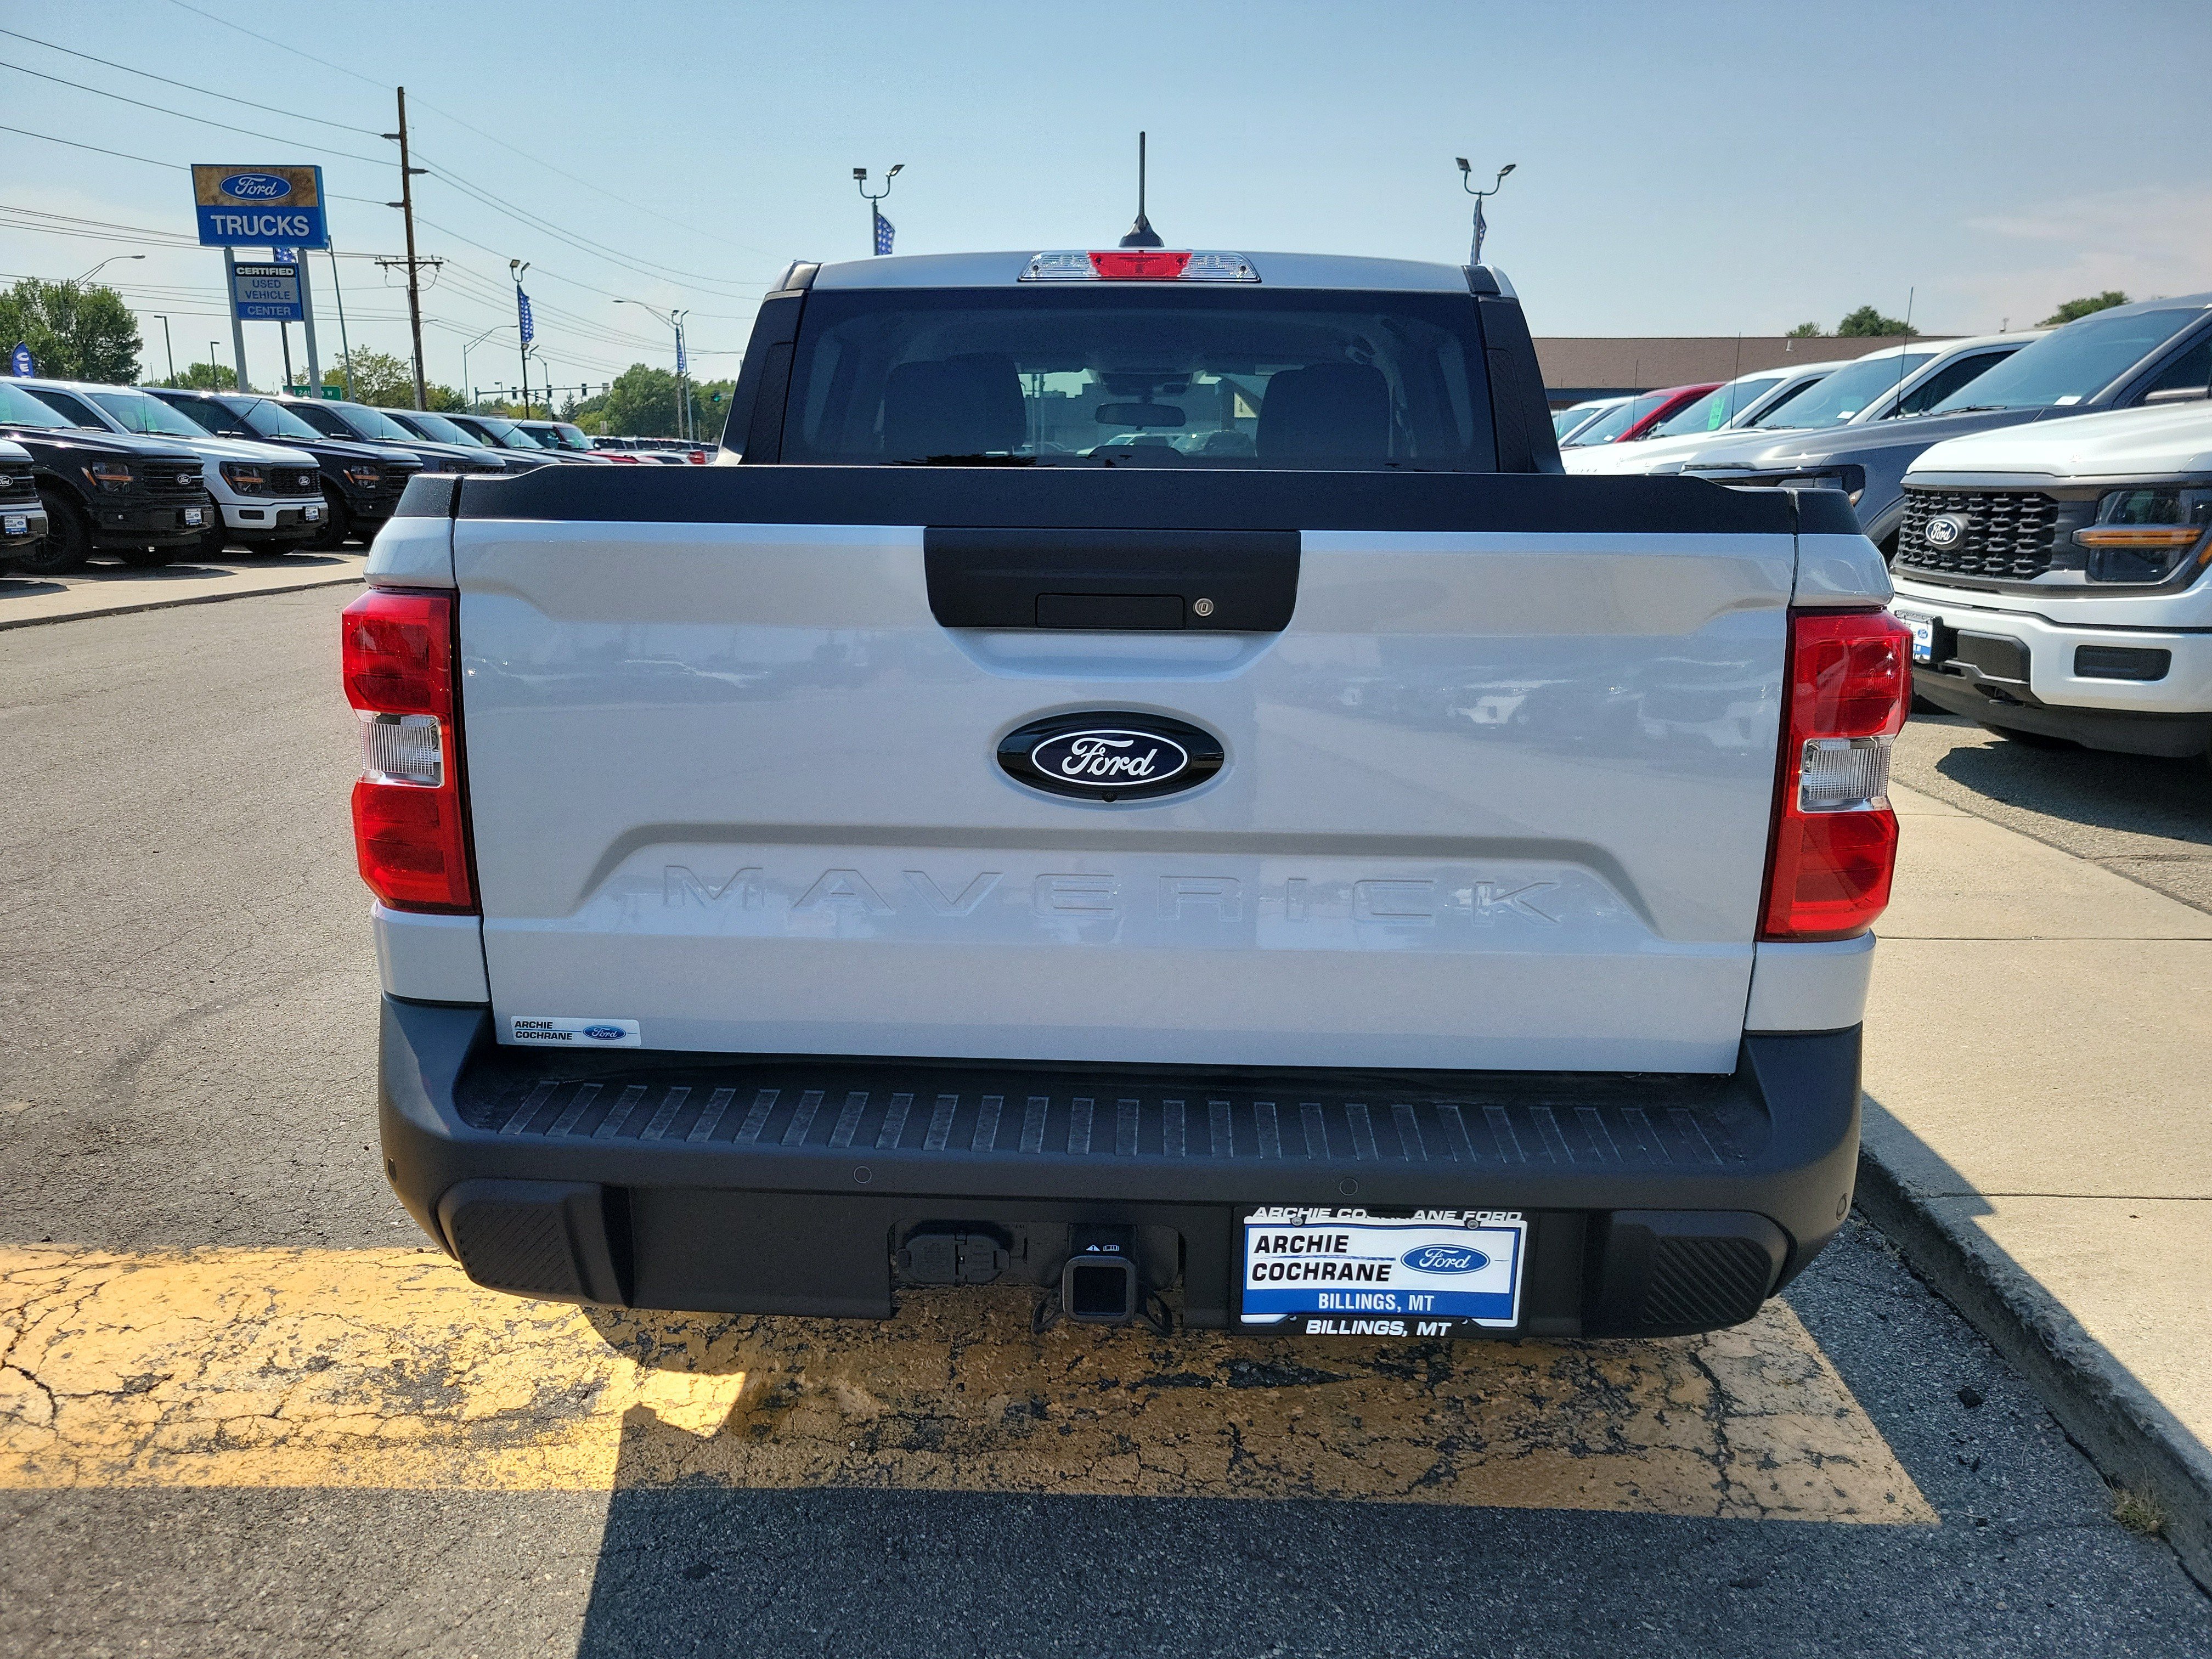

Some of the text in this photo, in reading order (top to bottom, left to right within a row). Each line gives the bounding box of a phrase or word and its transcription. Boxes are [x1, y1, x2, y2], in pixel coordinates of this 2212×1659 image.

[235, 177, 278, 196] Ford
[211, 215, 309, 236] TRUCKS
[236, 267, 294, 275] CERTIFIED
[252, 279, 281, 288] USED
[245, 290, 291, 300] VEHICLE
[247, 305, 291, 315] CENTER
[1931, 522, 1952, 541] Ford
[1062, 737, 1158, 776] Ford
[662, 865, 1565, 926] MAVERICK
[514, 1020, 553, 1029] ARCHIE
[591, 1027, 618, 1038] Ford
[515, 1031, 573, 1040] COCHRANE
[1252, 1206, 1522, 1222] ARCHIE COANE FORD
[1254, 1235, 1350, 1254] ARCHIE
[1419, 1248, 1470, 1269] Ford
[1251, 1262, 1392, 1282] COCHRANE
[1318, 1293, 1435, 1313] BILLINGS, MT
[1305, 1319, 1452, 1337] BILLINGS, MT
